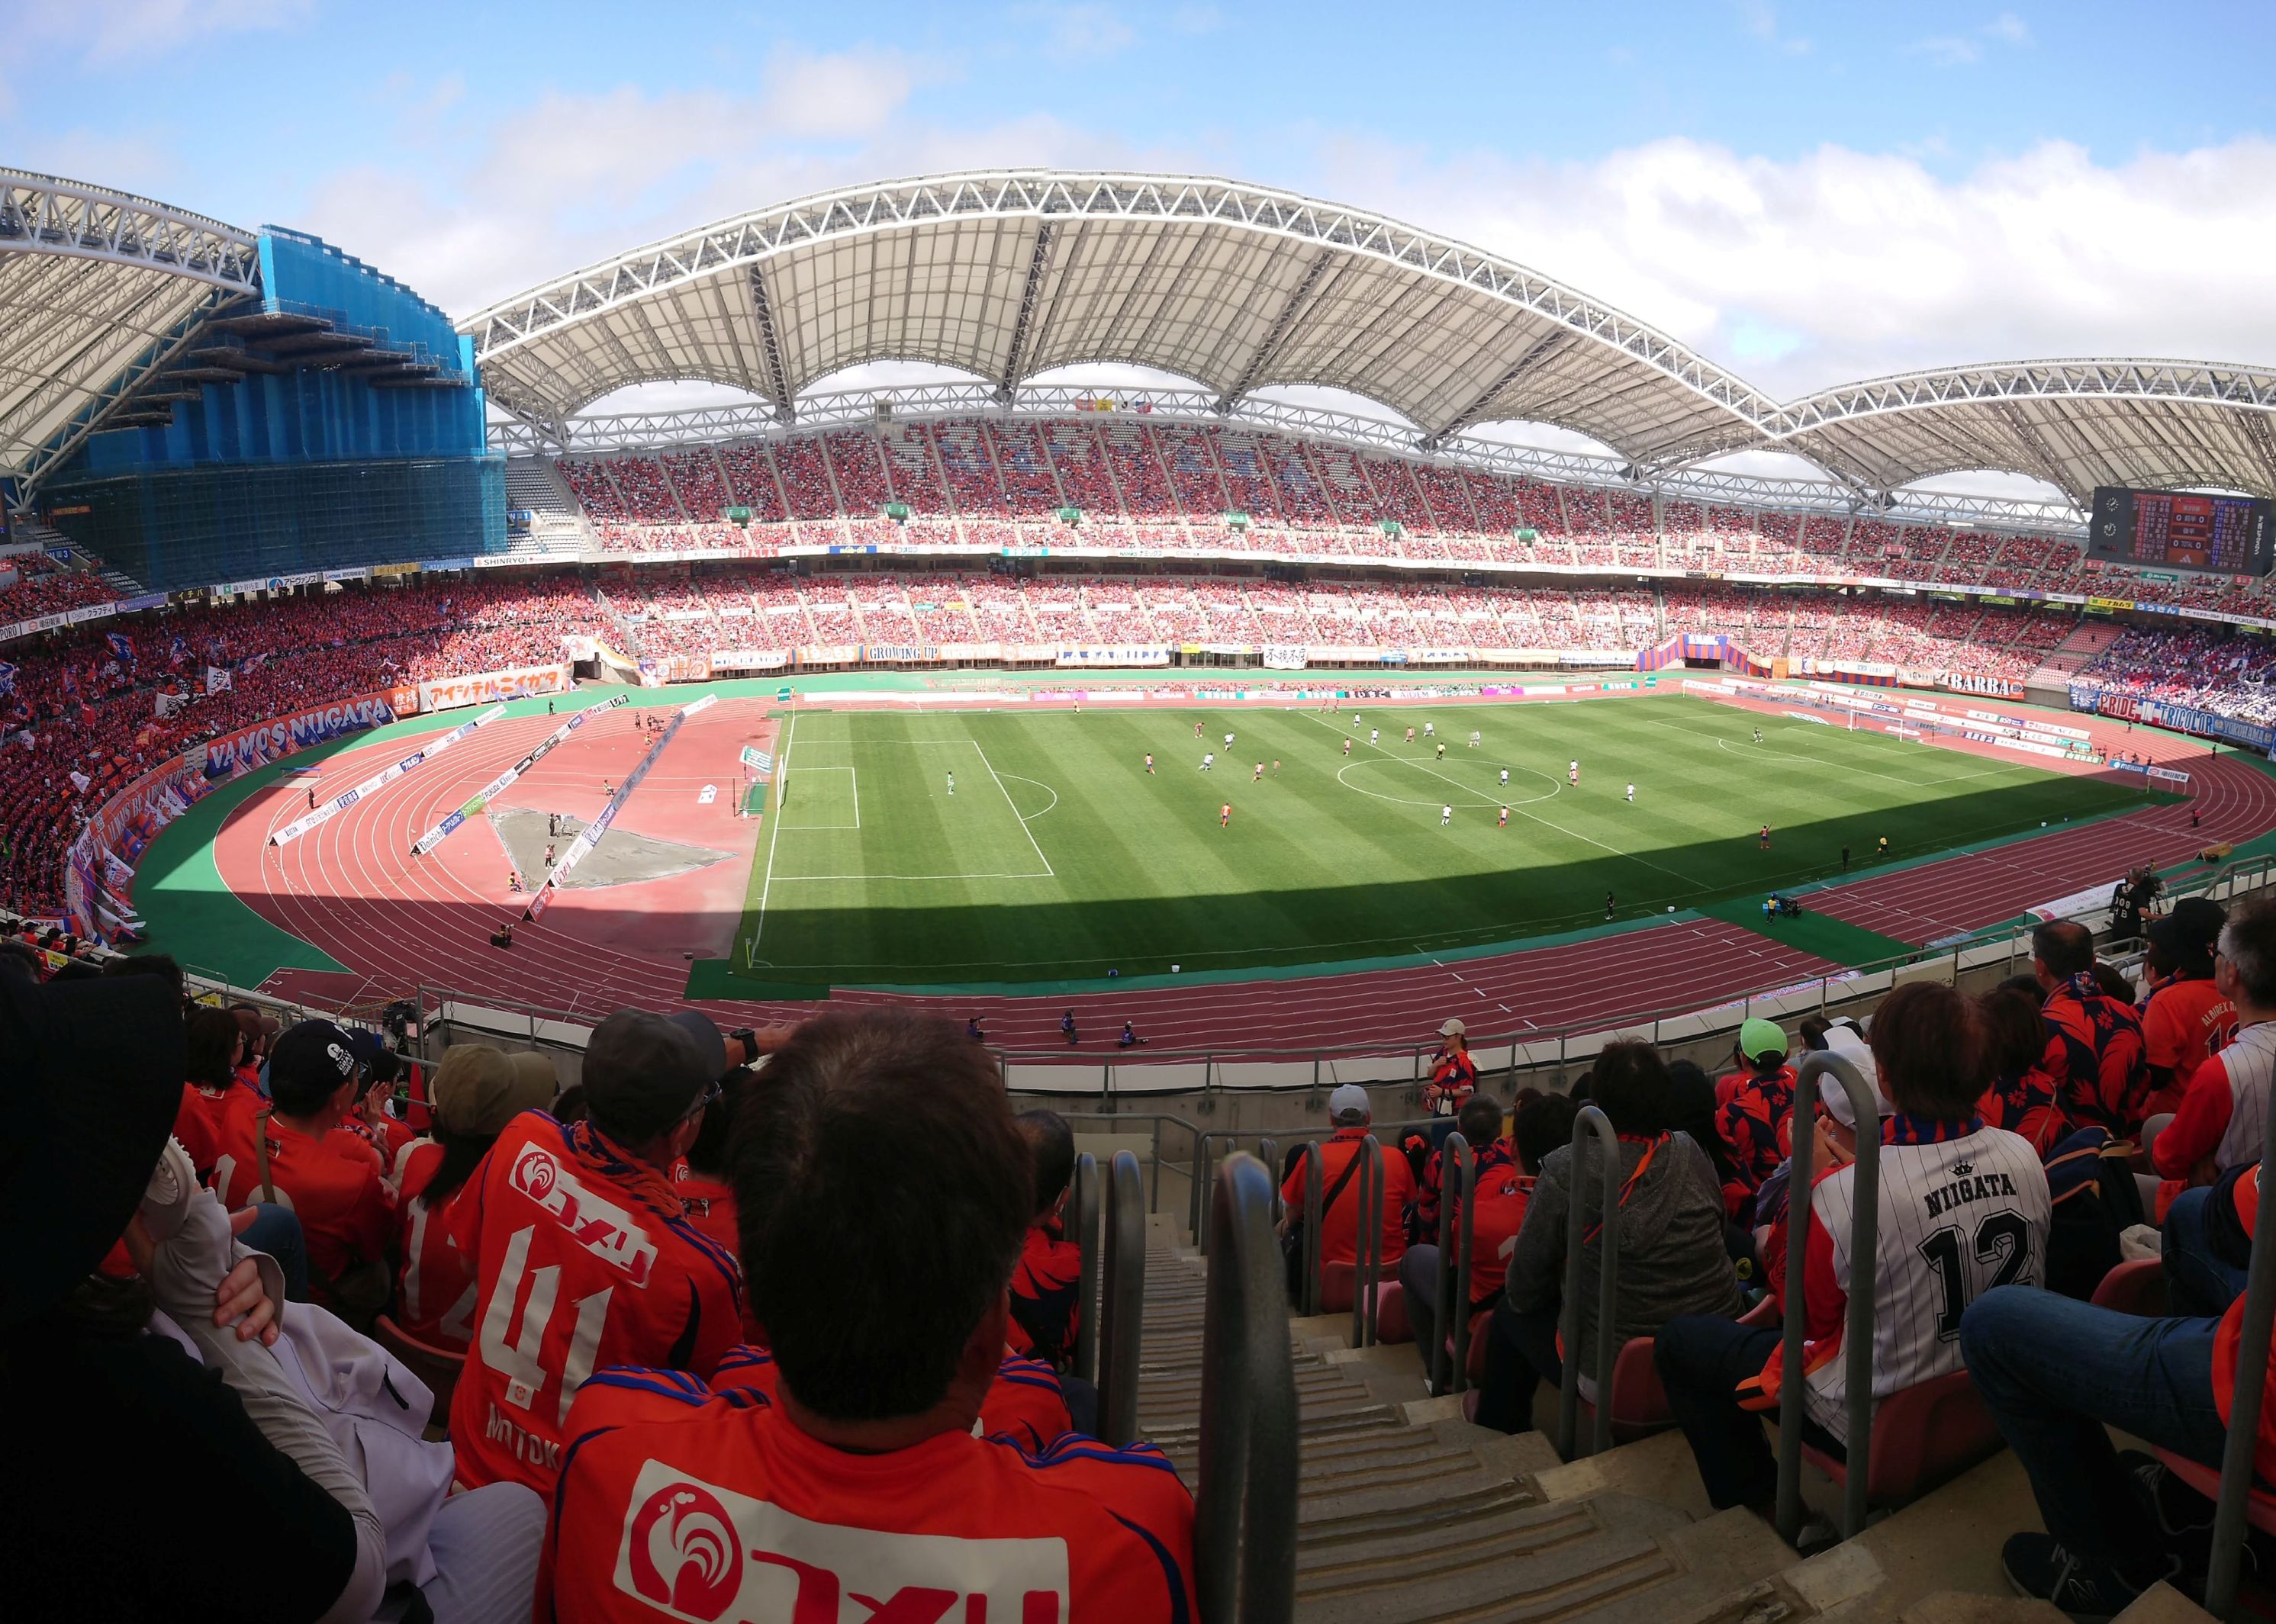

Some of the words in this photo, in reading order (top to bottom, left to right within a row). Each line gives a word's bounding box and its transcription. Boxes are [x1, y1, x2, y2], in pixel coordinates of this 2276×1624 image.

[484, 557, 525, 566] SHINRYO
[284, 575, 317, 587] アドヴァンス
[88, 606, 112, 617] クラフティ
[2107, 600, 2132, 608] ナカムラ
[2136, 603, 2177, 615] ろうきん
[2234, 616, 2261, 625] FUKUDA
[869, 646, 921, 660] GROWING
[924, 645, 938, 659] UP
[430, 671, 559, 705] アイシテルニイガタ
[1950, 672, 2010, 696] BARBA
[1400, 690, 1430, 699] AIDEM
[2099, 692, 2139, 720] PRIDE
[2140, 700, 2155, 722] IN
[2158, 703, 2215, 736] TRICOLOR
[209, 722, 286, 769] VAMOS
[288, 697, 388, 741] NIIGATA
[2223, 719, 2265, 744] YOKOHAMA
[2120, 764, 2144, 773] MEIWA
[2201, 1001, 2229, 1027] ALBIREX
[1923, 1173, 2017, 1220] NIIGATA
[1916, 1208, 2036, 1343] 12
[480, 1224, 614, 1429] 41
